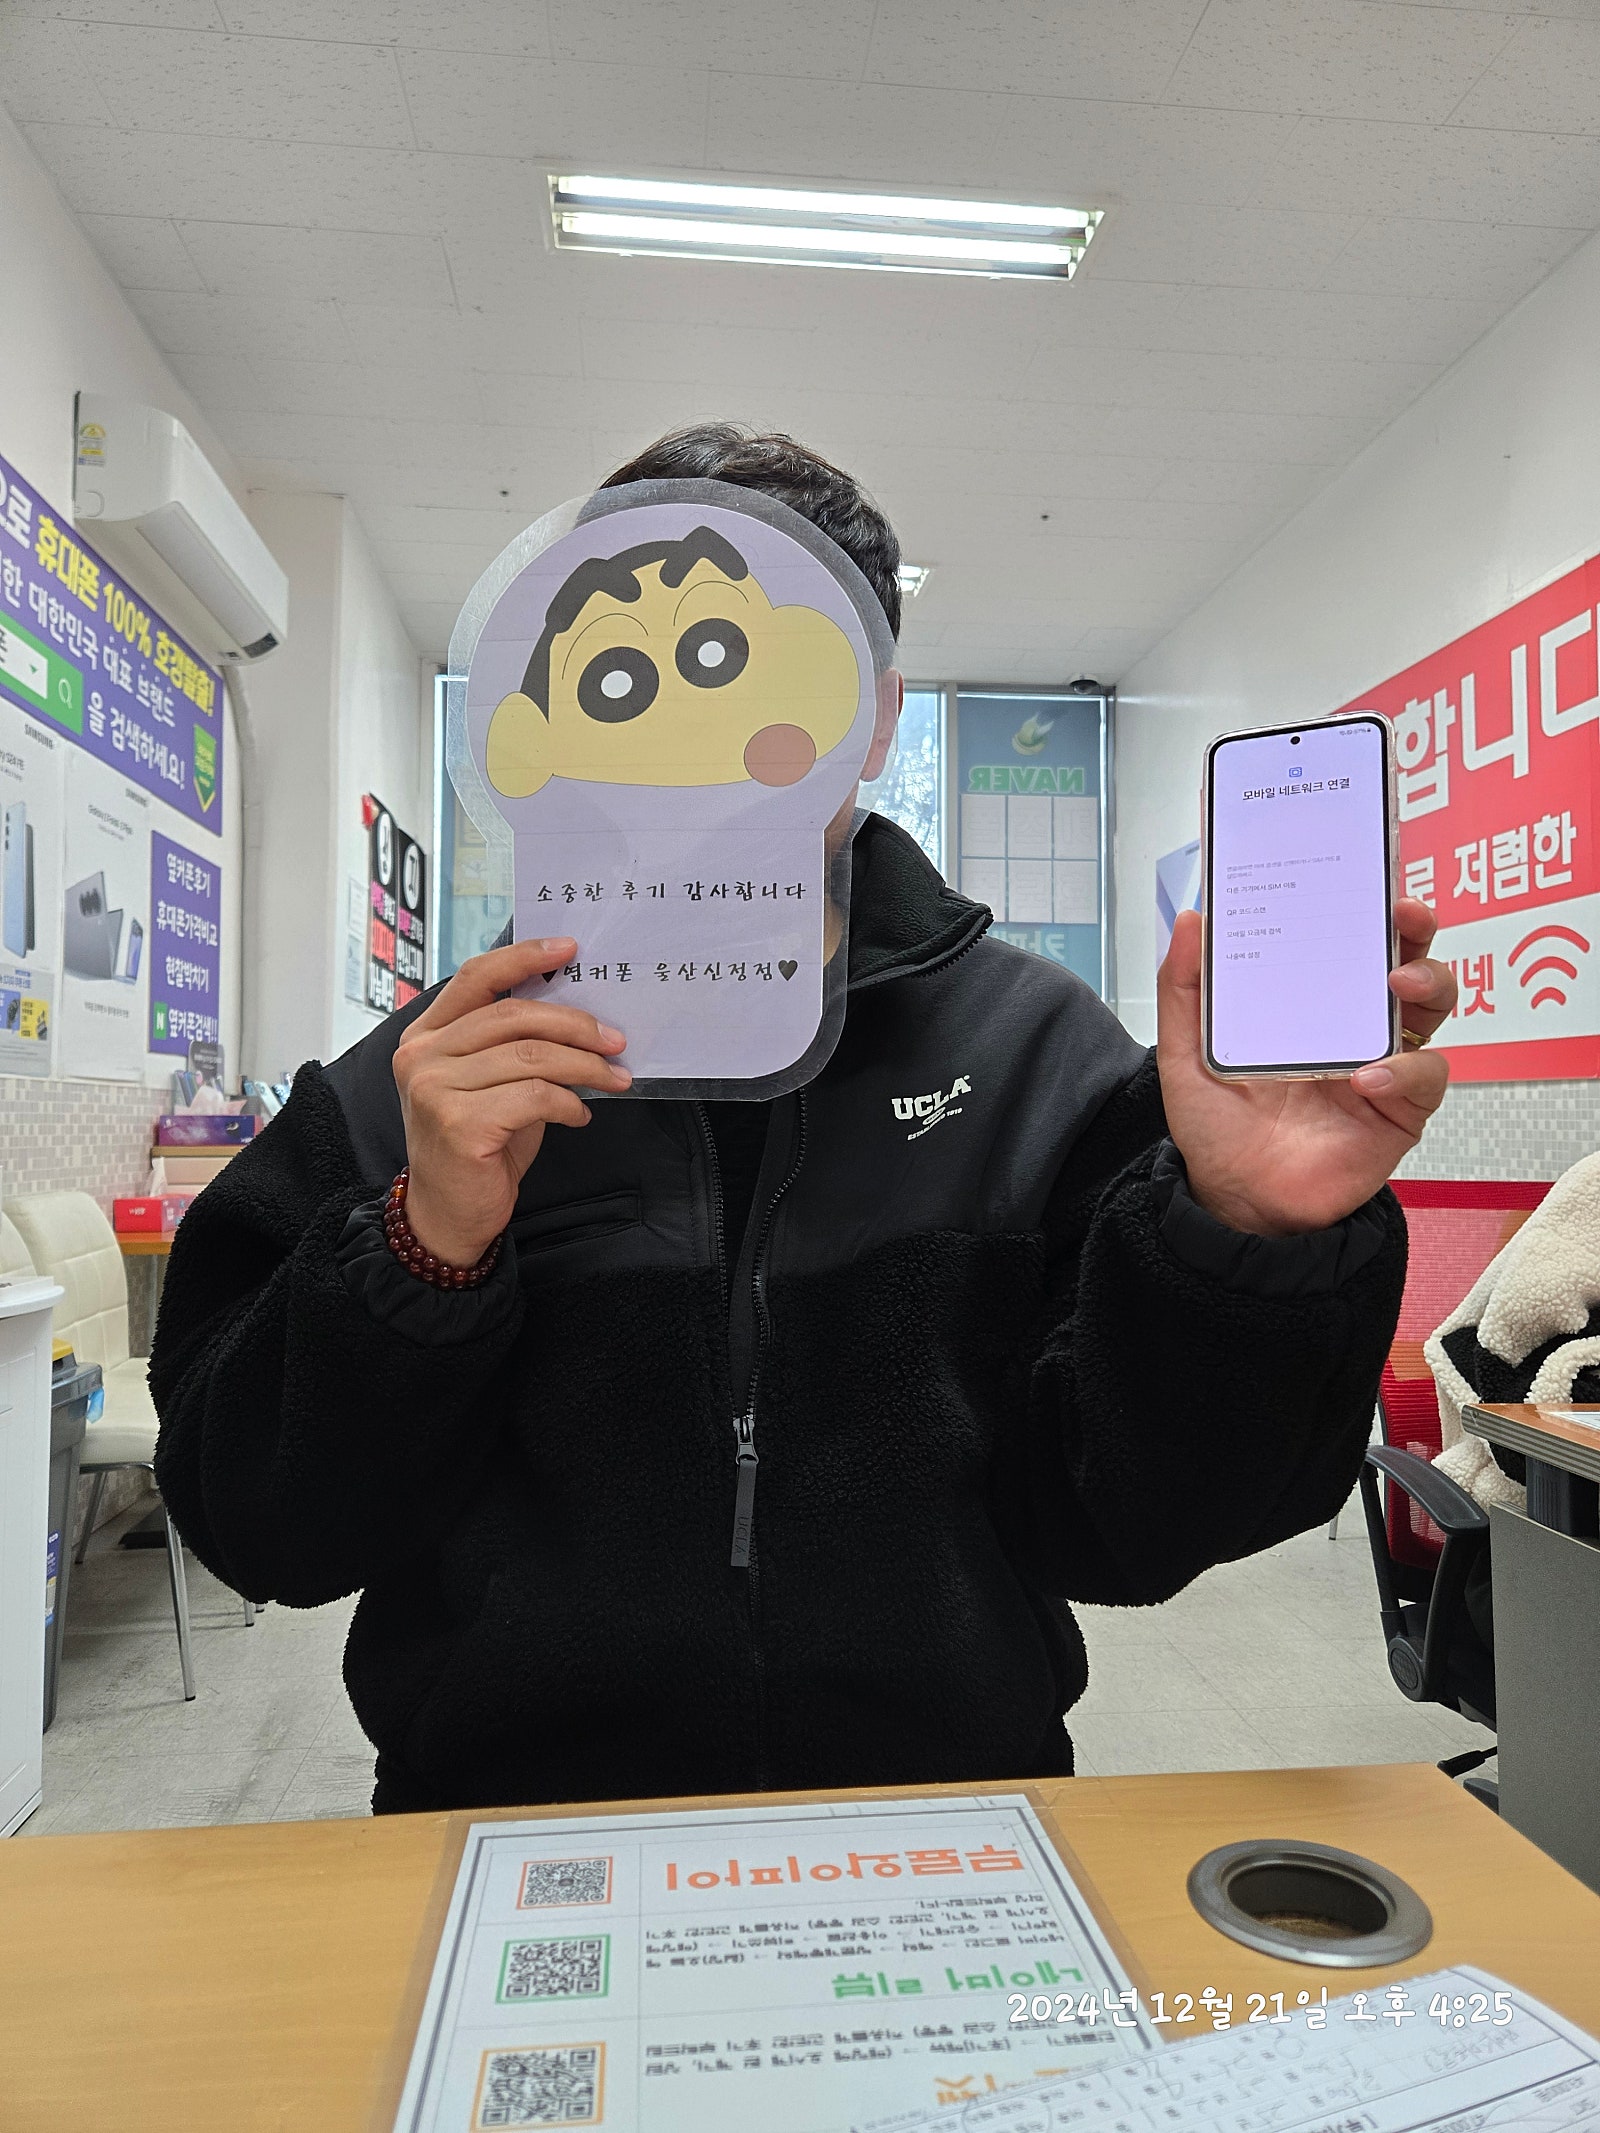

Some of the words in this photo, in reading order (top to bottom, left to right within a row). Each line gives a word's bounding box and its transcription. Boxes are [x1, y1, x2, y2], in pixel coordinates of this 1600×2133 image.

[35, 514, 100, 612] 휴대폰
[103, 583, 152, 658] 100%
[28, 581, 98, 670] 대한민국
[103, 640, 133, 693] 대표
[136, 670, 176, 727] 브랜드
[88, 691, 106, 737] 을
[110, 706, 185, 790] 검색하세요!
[1242, 787, 1275, 801] 모바일
[1279, 782, 1324, 796] 네트워크
[1327, 777, 1350, 791] 연결
[167, 852, 210, 898] 옆커폰후기
[1453, 811, 1577, 905] 저렴한
[537, 882, 604, 903] 소중한
[622, 880, 665, 901] 후기
[683, 880, 806, 901] 감사합니다
[1268, 883, 1281, 891] SIM
[157, 900, 218, 947] 휴대폰가격비교
[563, 962, 633, 982] 옆커폰
[653, 961, 774, 982] 울산신정점
[891, 1076, 972, 1120] UCLA
[667, 1844, 1025, 1891] 무료와이파이
[964, 1937, 1010, 1949] 로그인
[1018, 1933, 1064, 1946] 네이버
[831, 1972, 923, 1999] 리뷰
[944, 1961, 1084, 1991] 네이버
